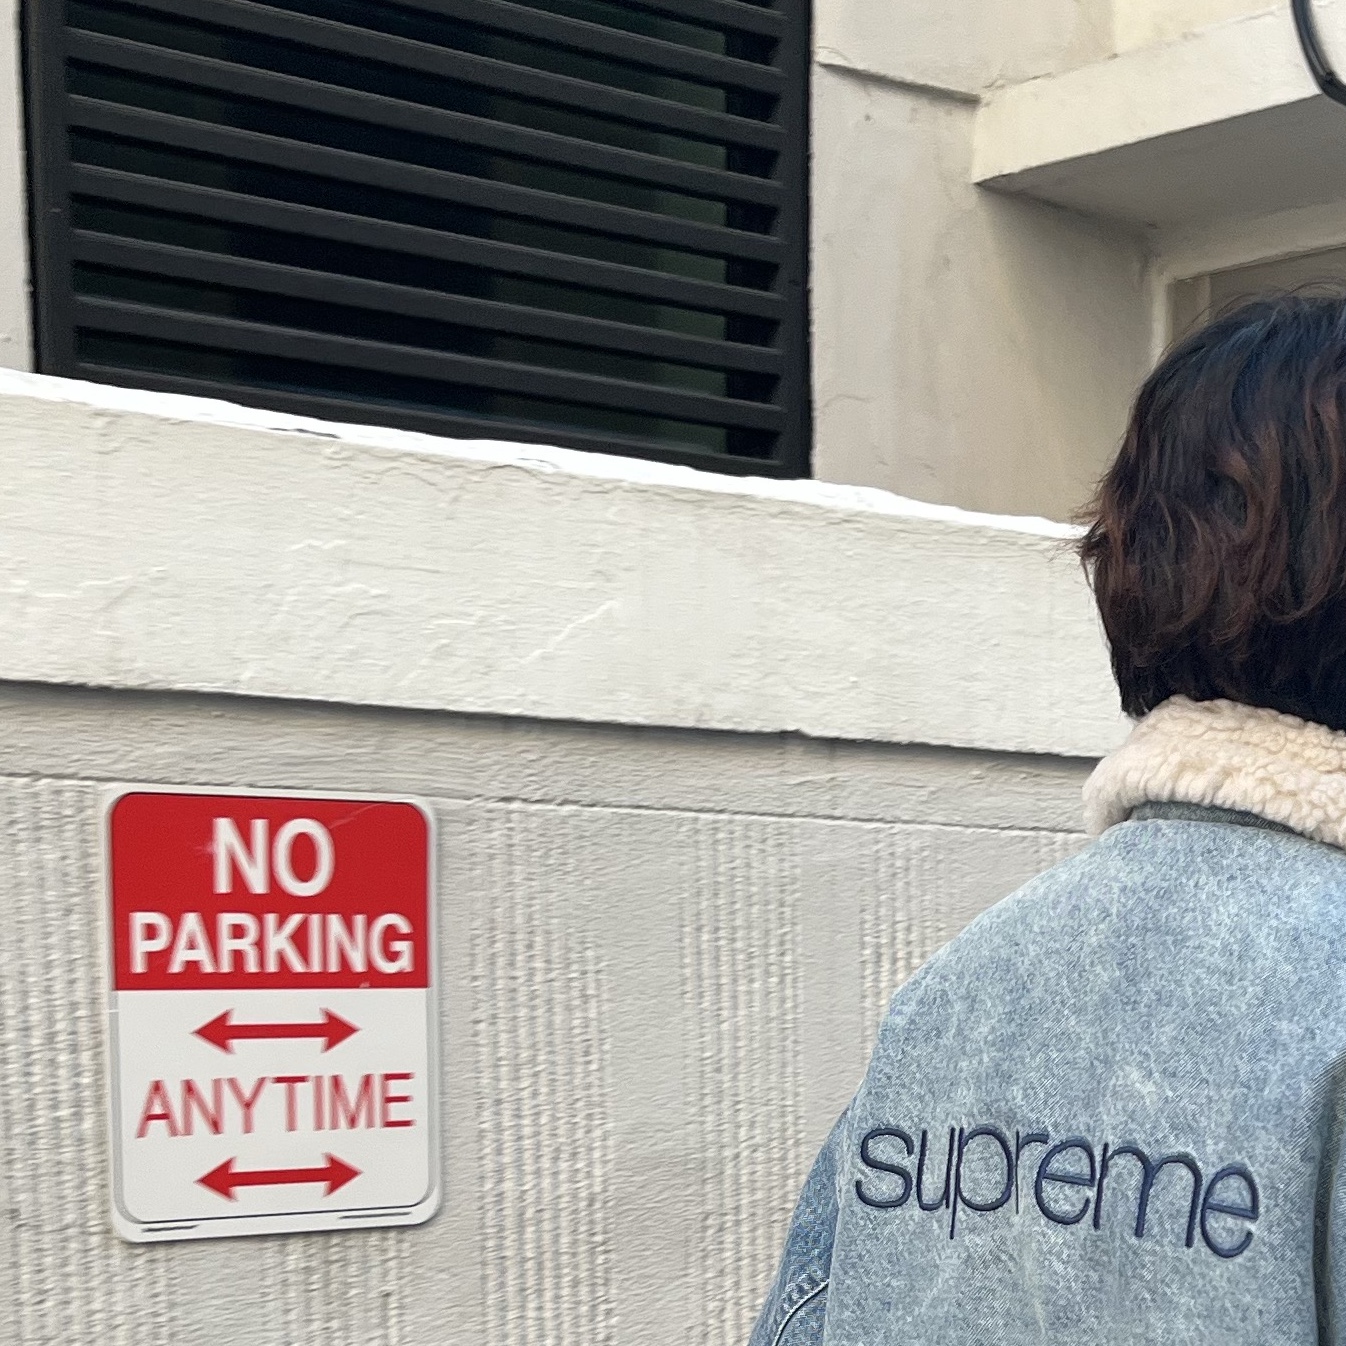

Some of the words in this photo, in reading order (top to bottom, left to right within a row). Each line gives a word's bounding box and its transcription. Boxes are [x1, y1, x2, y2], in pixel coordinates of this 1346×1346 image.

[212, 816, 335, 897] NO
[128, 911, 415, 975] PARKING
[134, 1072, 417, 1138] ANYTIME
[855, 1126, 1259, 1258] supreme
